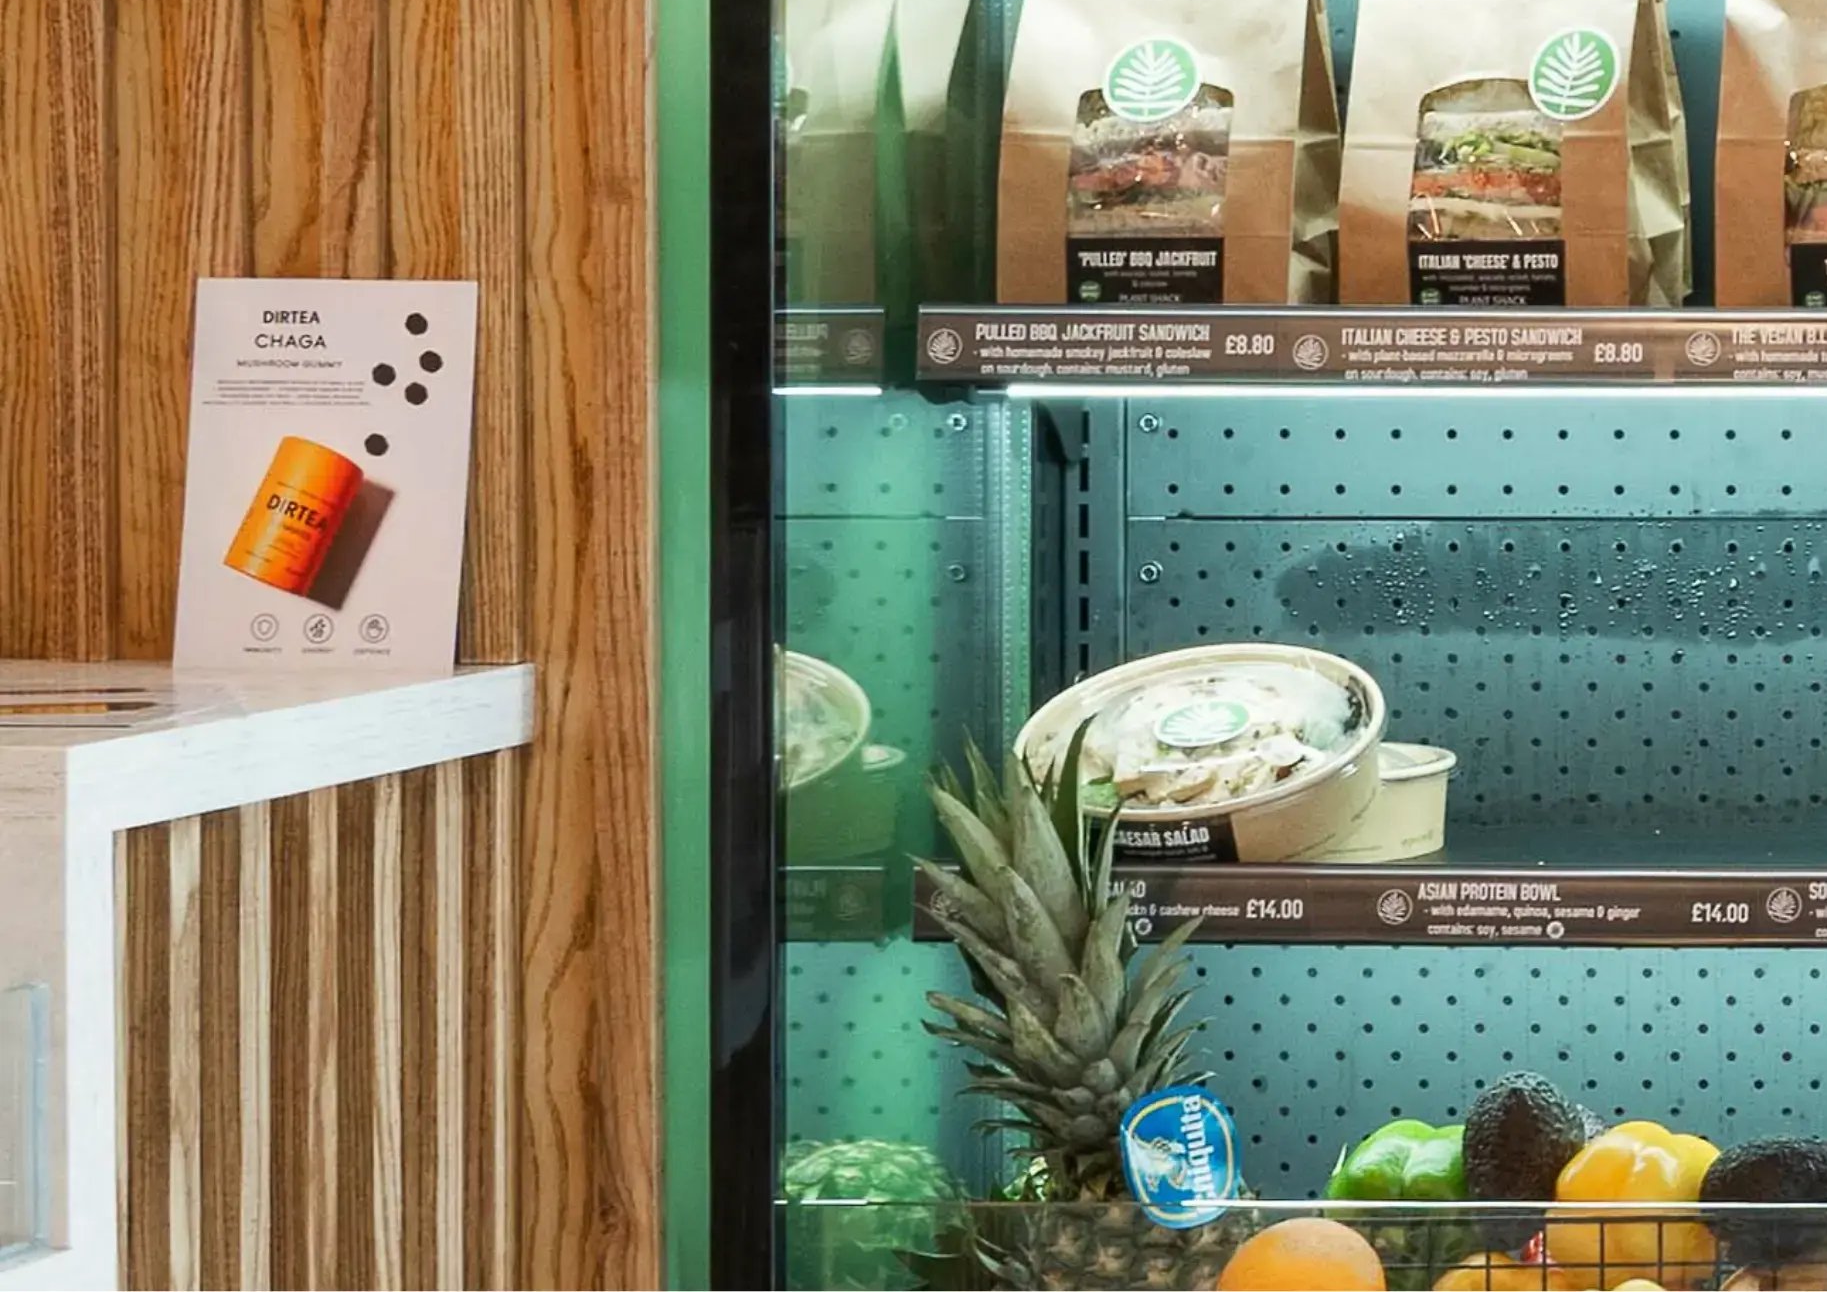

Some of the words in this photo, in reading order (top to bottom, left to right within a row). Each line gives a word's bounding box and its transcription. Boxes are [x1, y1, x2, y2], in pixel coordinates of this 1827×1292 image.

[263, 311, 320, 324] DIRTEA
[976, 324, 1026, 340] PULLED
[1030, 324, 1057, 341] BBQ
[1062, 324, 1134, 341] JACKFRUIT
[1139, 324, 1210, 341] SANDWICH
[1342, 328, 1391, 345] ITALIAN
[1396, 328, 1446, 345] CHEESE
[1450, 329, 1460, 345] &
[1465, 328, 1507, 345] PESTO
[1511, 328, 1582, 345] SANDWICH
[255, 335, 326, 349] CHAGA
[1226, 335, 1273, 355] £8.80
[1595, 343, 1642, 362] £8.80
[268, 494, 328, 531] DIRTEA
[1418, 883, 1455, 900] ASIAN
[1460, 883, 1516, 900] PROTEIN
[1521, 883, 1561, 901] BOWL
[1692, 903, 1748, 923] £14.00
